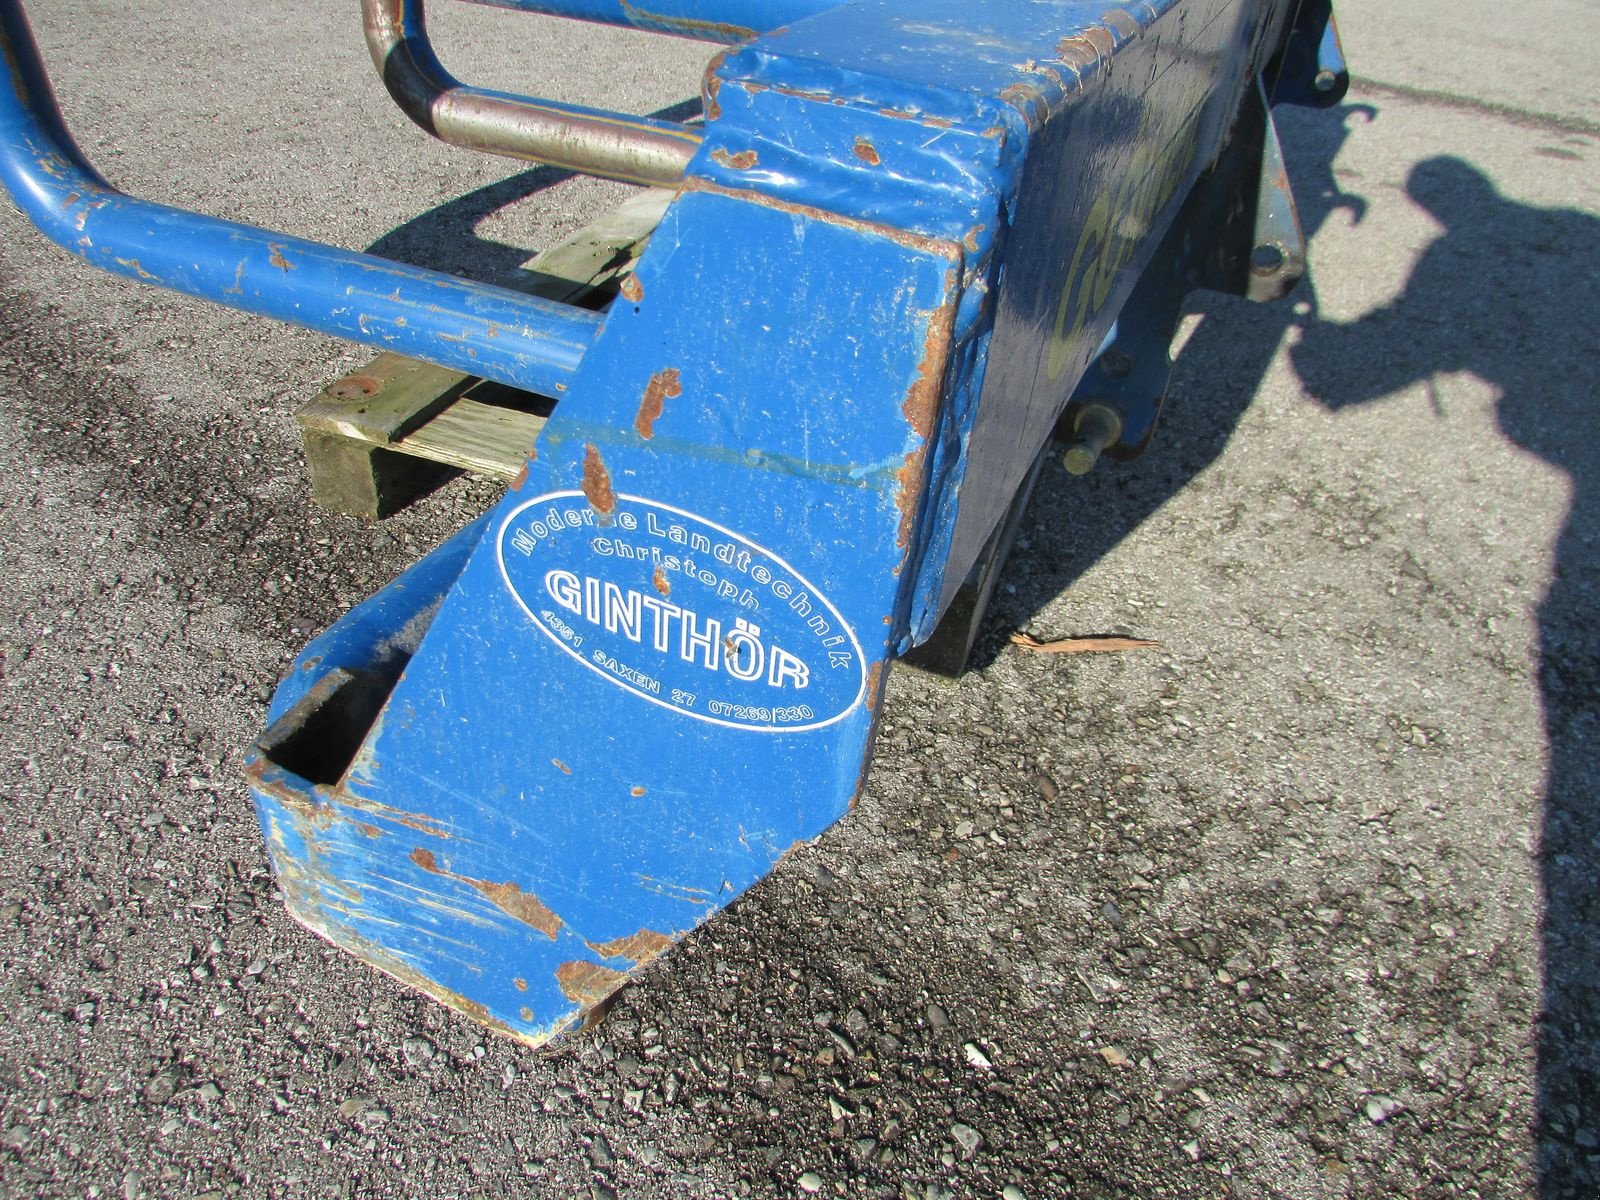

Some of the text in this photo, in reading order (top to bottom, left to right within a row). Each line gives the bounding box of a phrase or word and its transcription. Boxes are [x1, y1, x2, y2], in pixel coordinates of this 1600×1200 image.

[592, 536, 761, 611] Christoph
[647, 511, 853, 670] Landtechnik
[540, 609, 585, 648] 4351
[592, 649, 662, 694] SAXEN
[671, 688, 697, 707] 27
[545, 569, 811, 690] GINTHÖR
